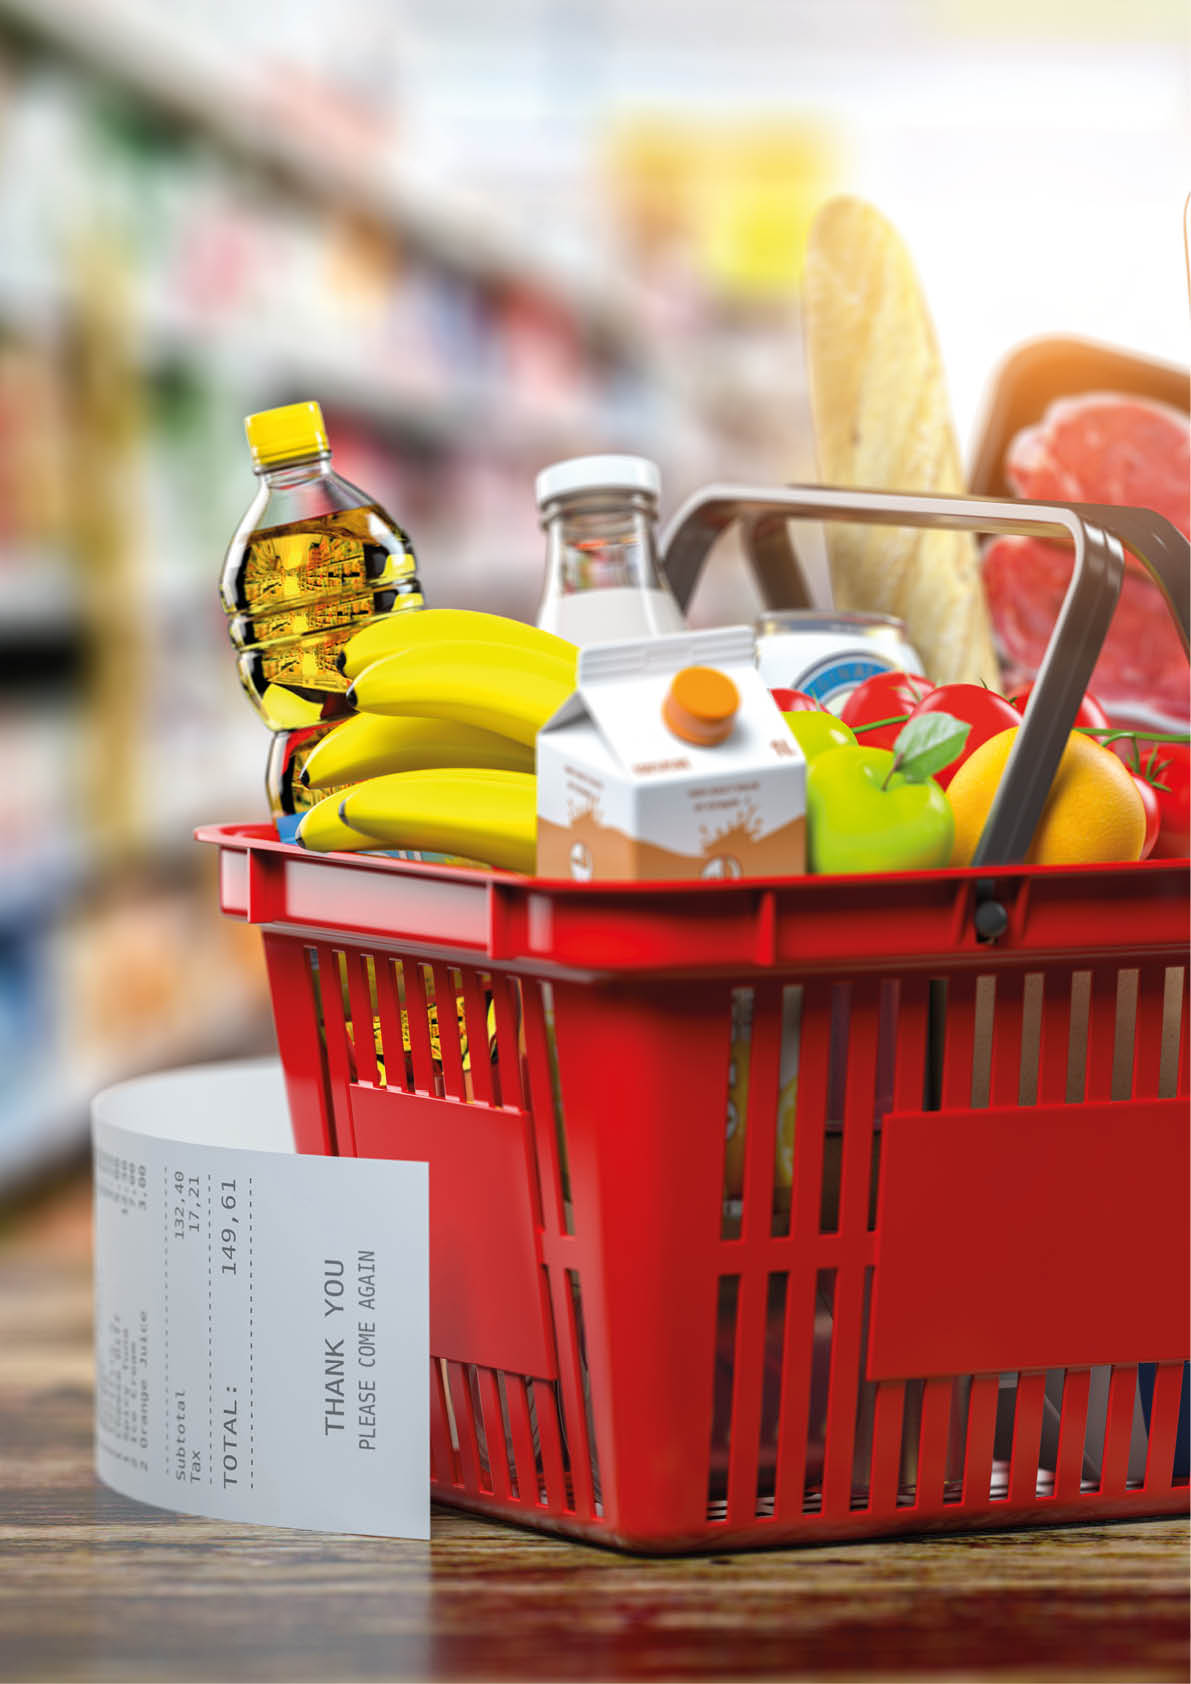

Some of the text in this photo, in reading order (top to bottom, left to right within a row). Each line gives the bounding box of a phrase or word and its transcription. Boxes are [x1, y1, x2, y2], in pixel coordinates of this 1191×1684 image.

[174, 1170, 187, 1239] 132,40
[189, 1176, 202, 1233] 17,21
[221, 1179, 239, 1276] 149,61
[138, 1311, 150, 1473] 2 Orange Juice
[323, 1259, 345, 1436] THANK YOU
[357, 1250, 377, 1451] PLEASE COME AGAIN
[175, 1391, 186, 1481] Subtotal
[190, 1450, 201, 1484] Tax
[222, 1386, 238, 1489] TOTAL:
